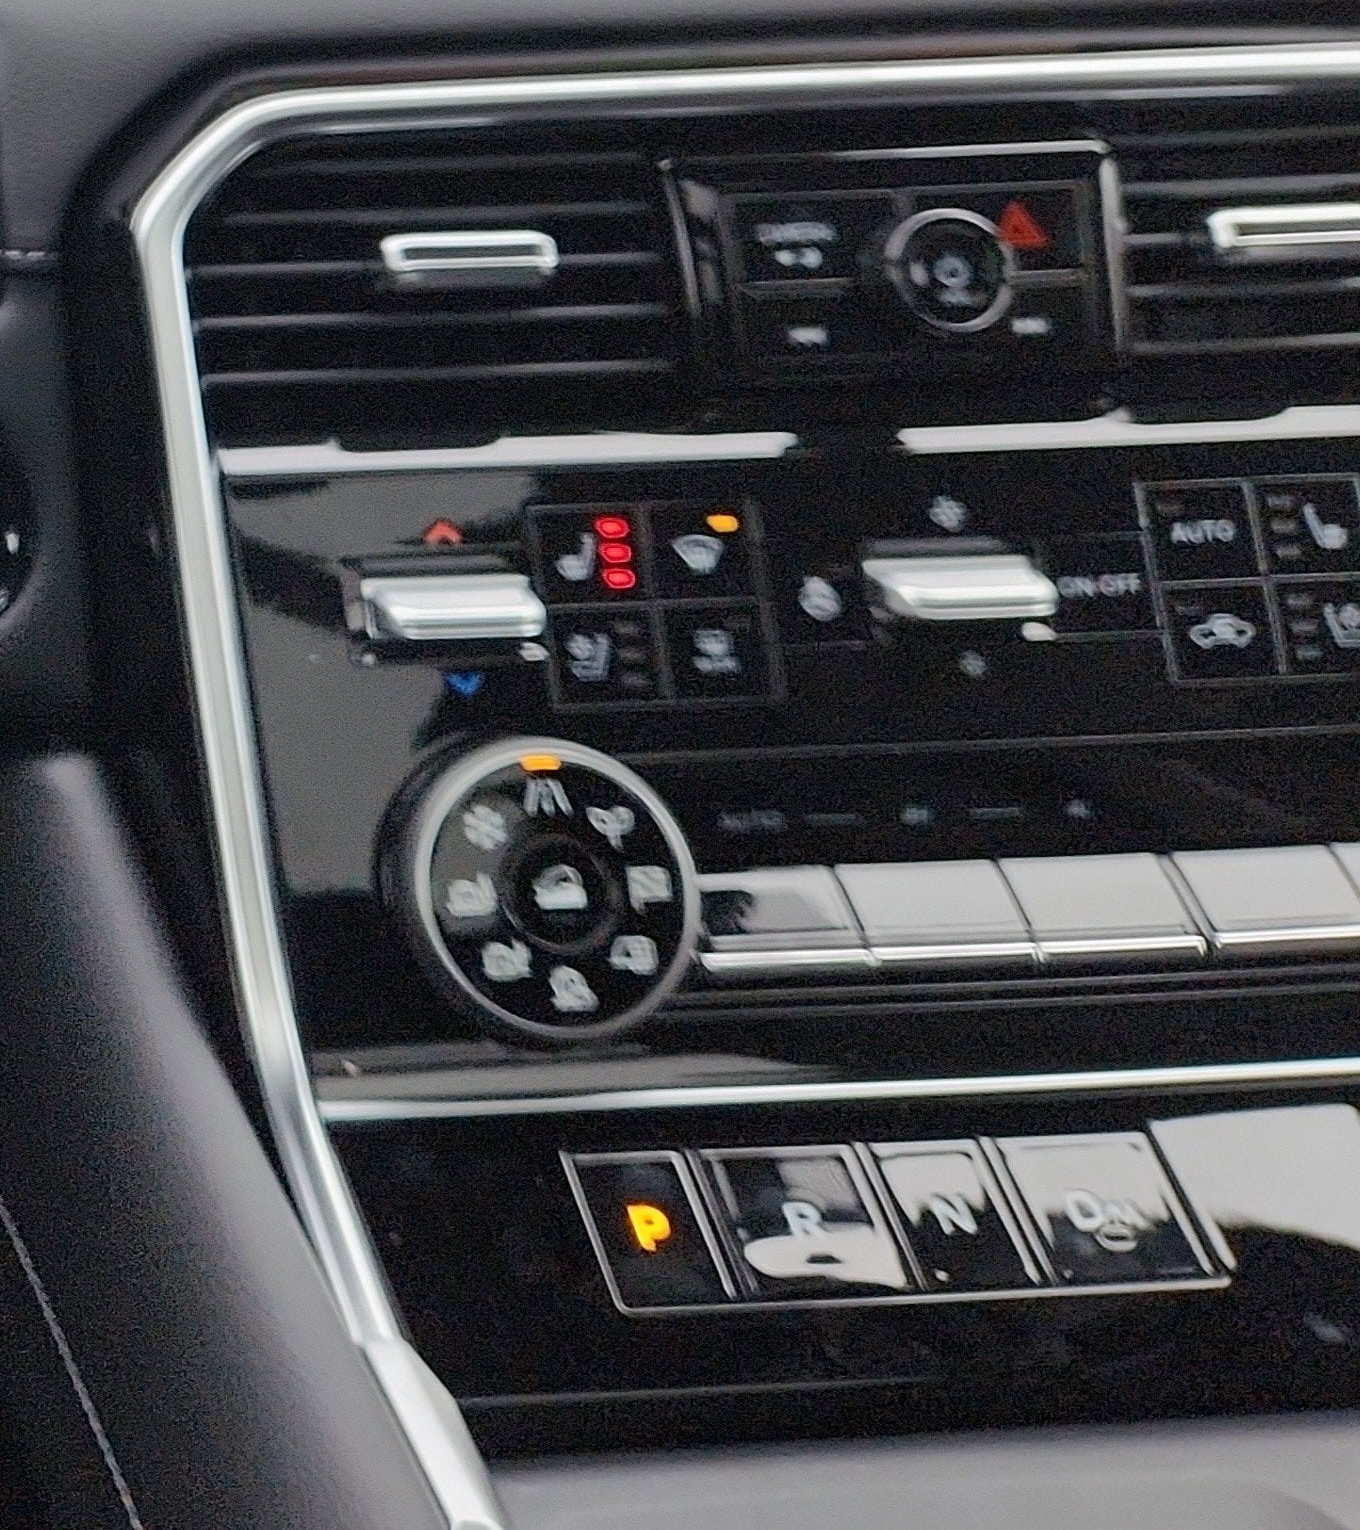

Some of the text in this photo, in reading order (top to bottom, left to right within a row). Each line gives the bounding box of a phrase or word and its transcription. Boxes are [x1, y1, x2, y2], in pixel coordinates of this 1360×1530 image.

[1170, 519, 1237, 545] AUTO
[627, 1203, 672, 1253] P
[783, 1201, 830, 1238] R
[930, 1192, 979, 1236] N
